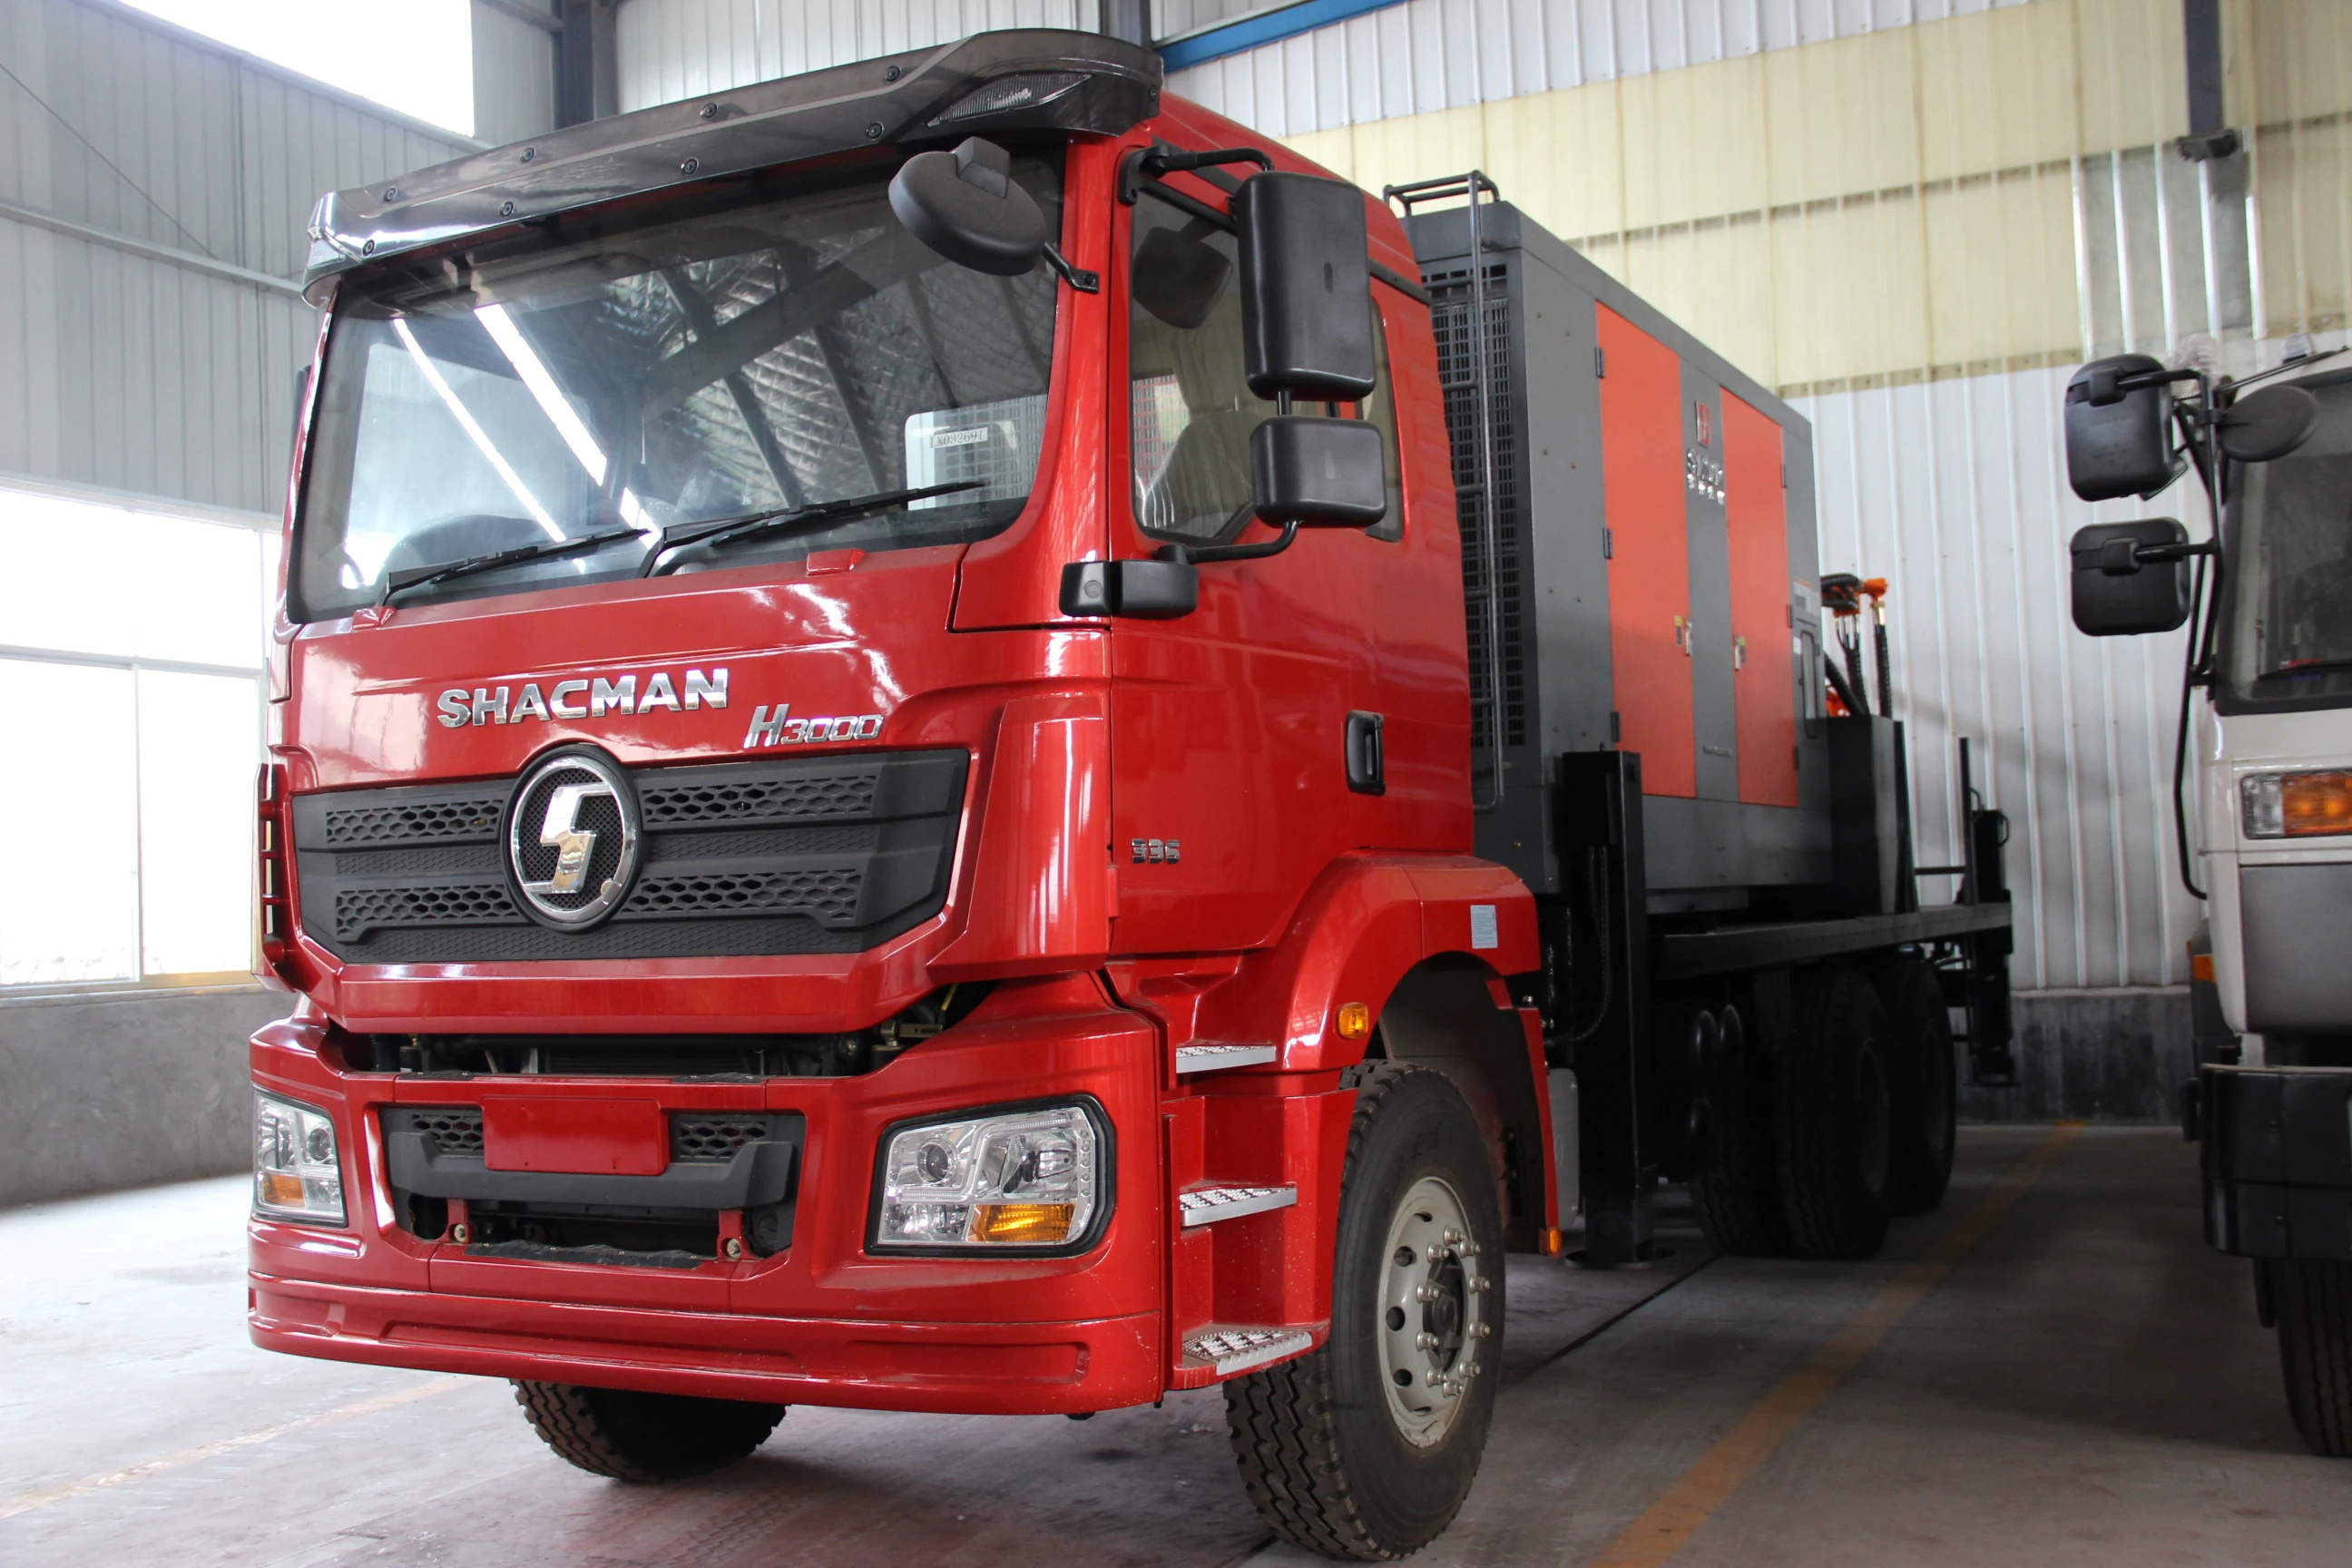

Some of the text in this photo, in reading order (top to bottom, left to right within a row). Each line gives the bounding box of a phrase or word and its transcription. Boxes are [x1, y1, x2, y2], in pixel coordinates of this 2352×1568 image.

[930, 430, 983, 447] LX032691
[436, 669, 729, 728] SHACMAN
[744, 703, 885, 749] H3000
[1132, 838, 1181, 864] 336
